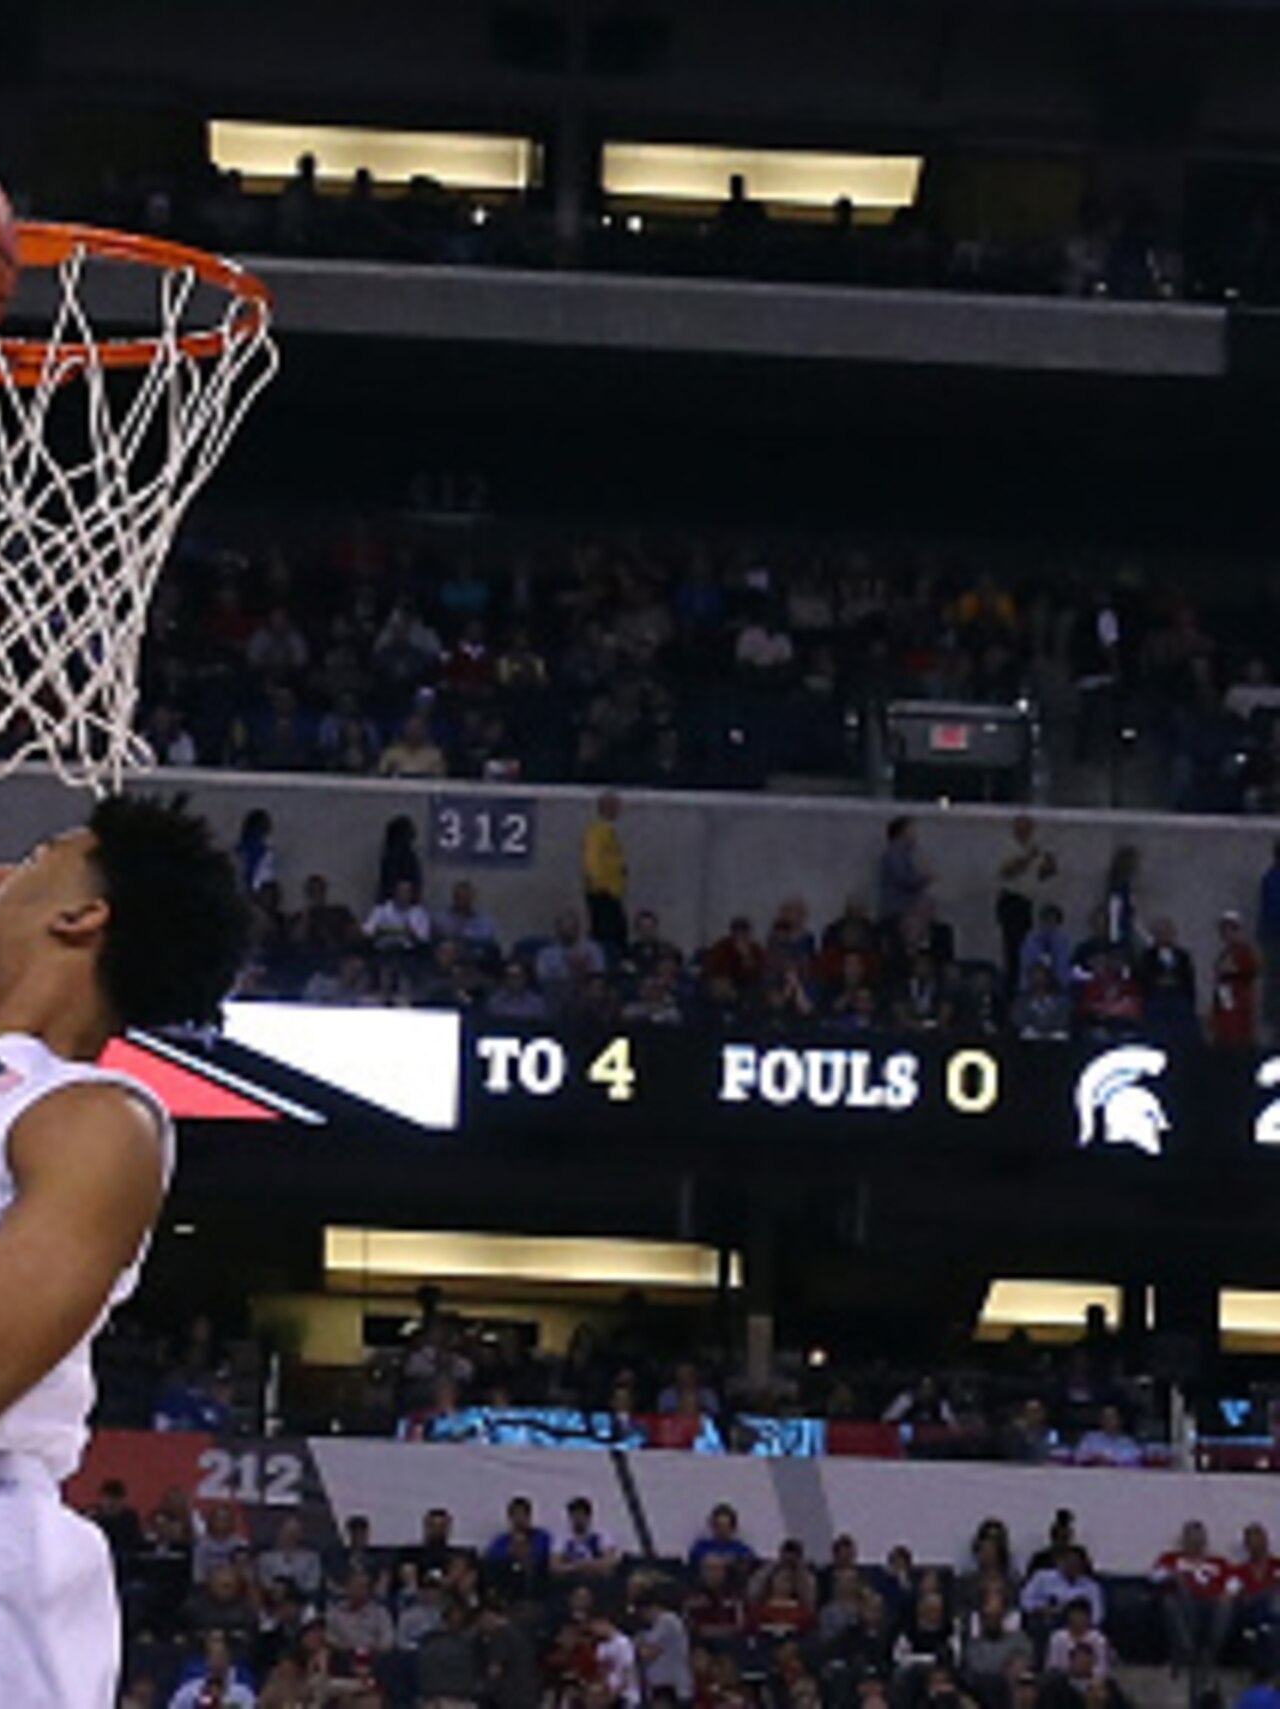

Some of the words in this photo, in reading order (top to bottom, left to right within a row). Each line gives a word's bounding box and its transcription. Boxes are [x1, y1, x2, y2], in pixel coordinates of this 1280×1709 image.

[438, 808, 528, 853] 312
[477, 1037, 565, 1094] TO
[588, 1036, 637, 1101] 4
[720, 1045, 919, 1109] FOULS
[946, 1048, 999, 1113] 0
[196, 1448, 304, 1505] 212
